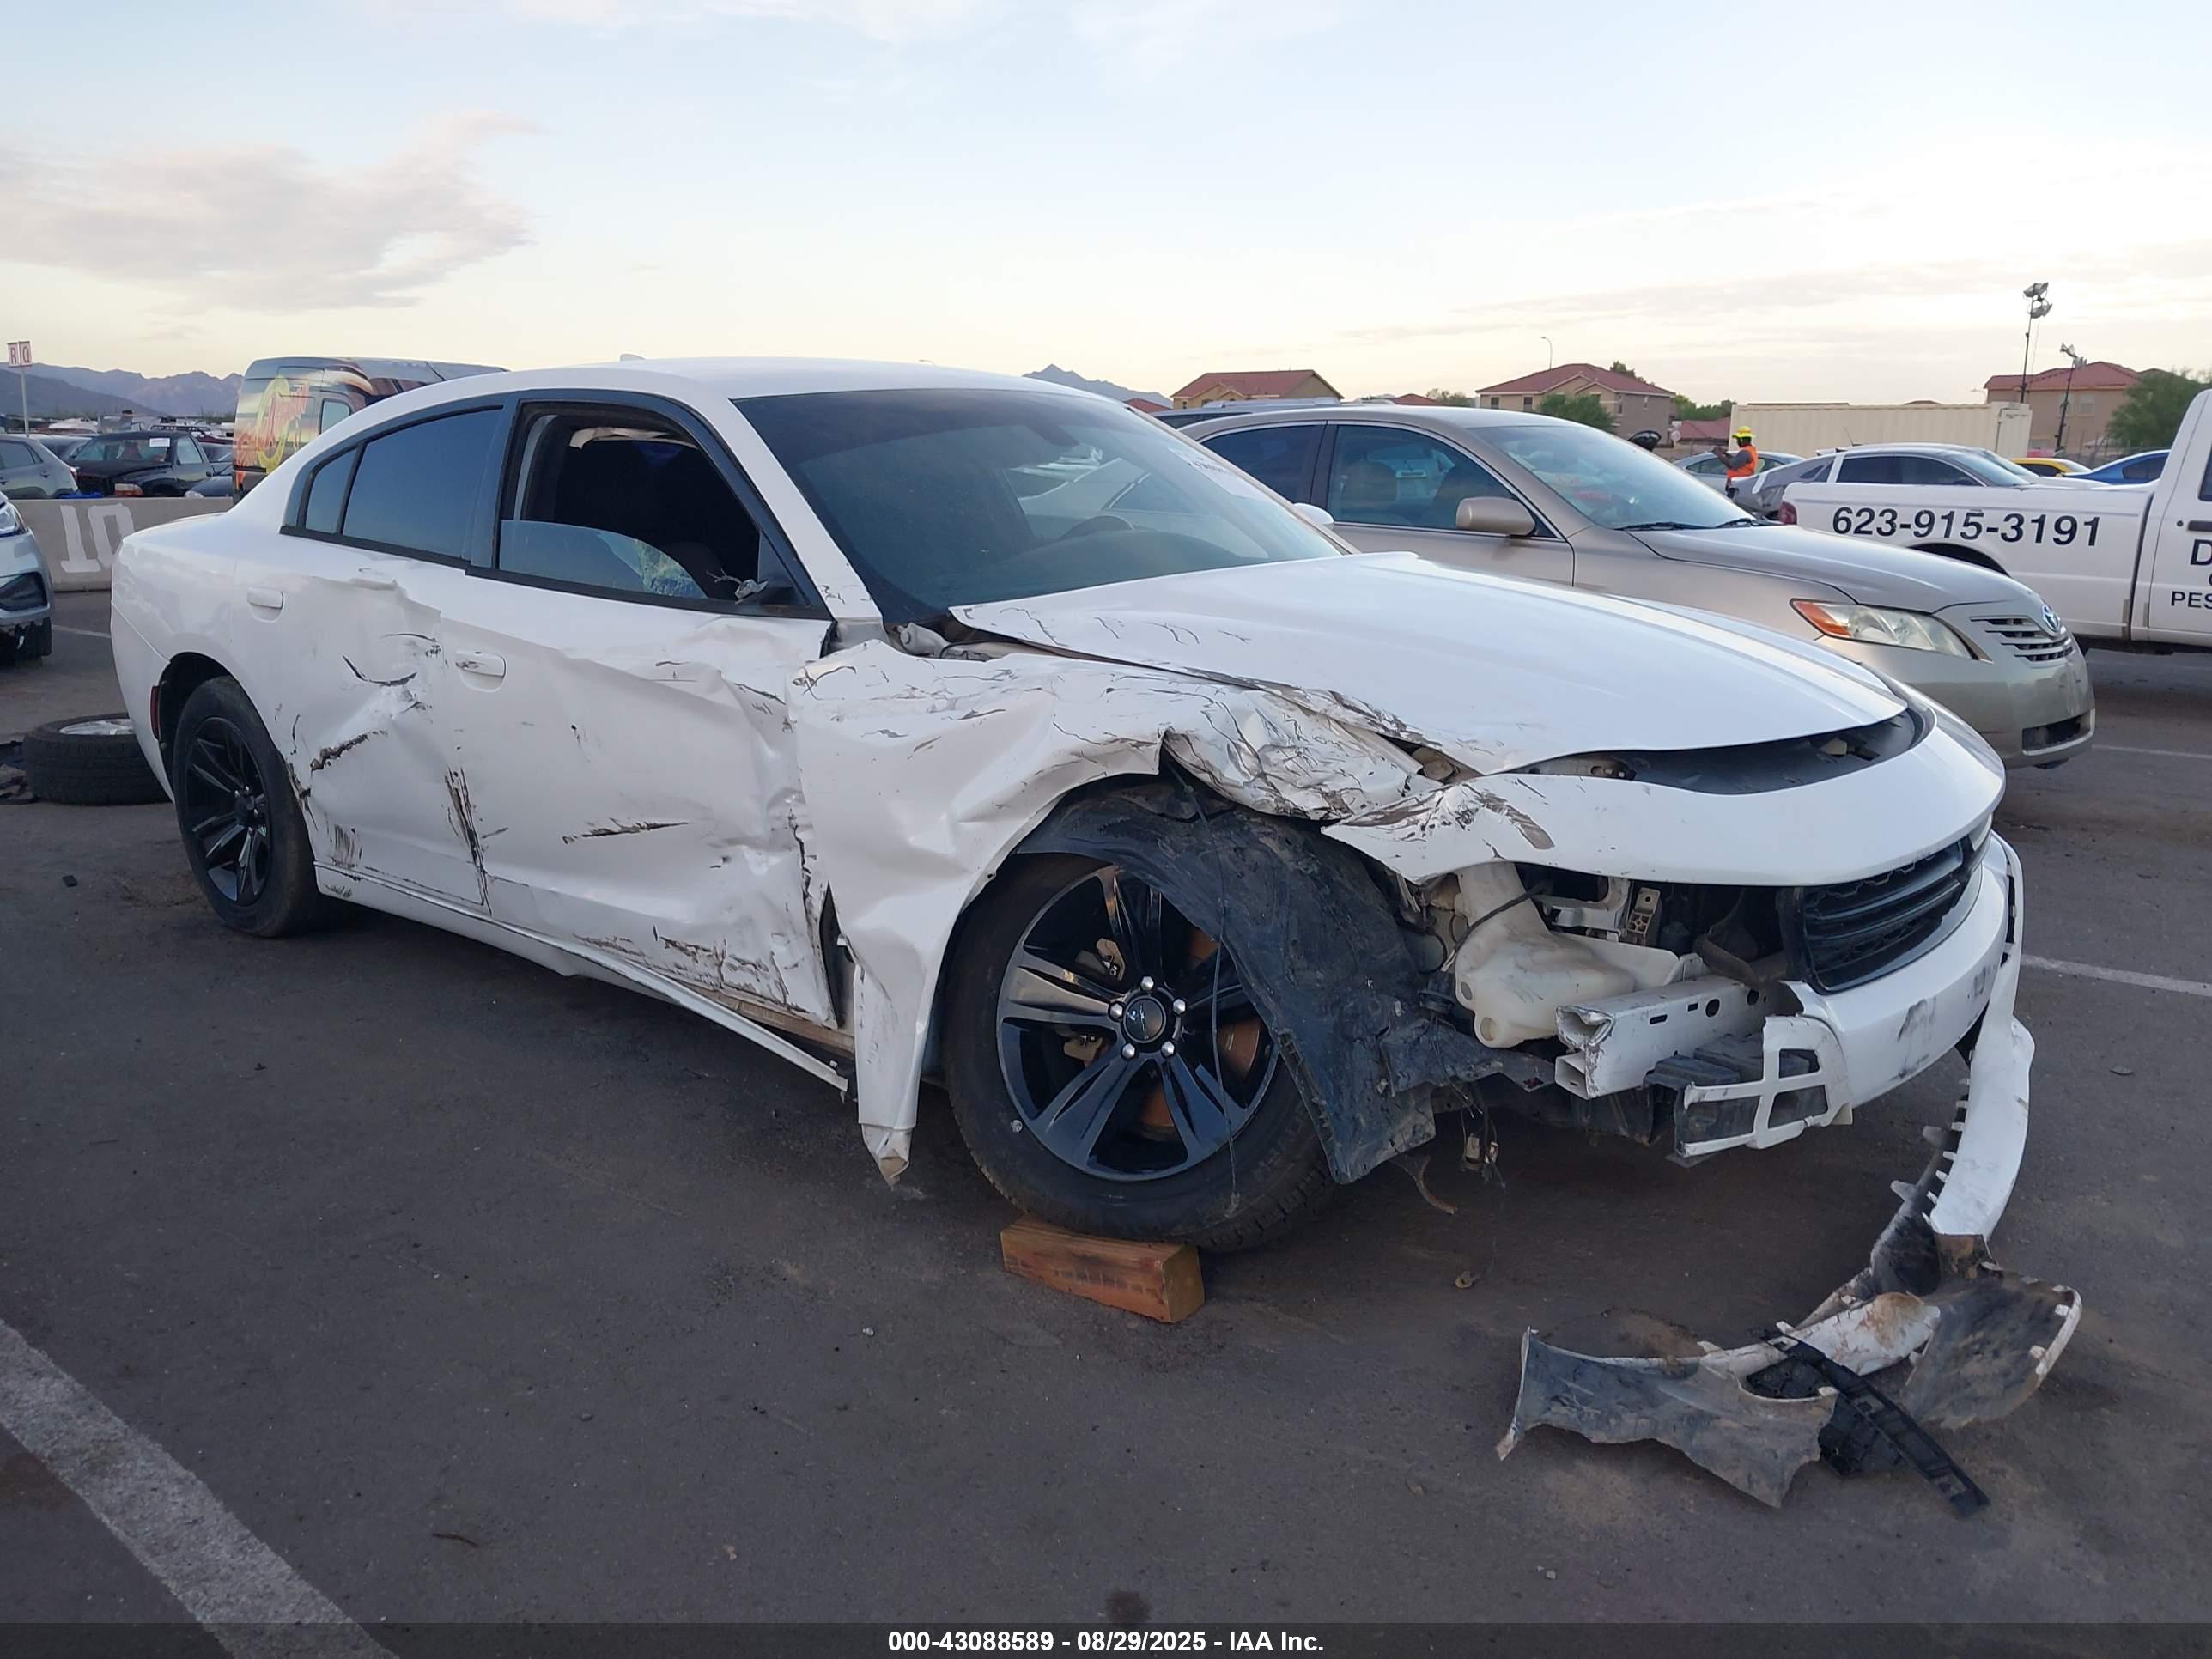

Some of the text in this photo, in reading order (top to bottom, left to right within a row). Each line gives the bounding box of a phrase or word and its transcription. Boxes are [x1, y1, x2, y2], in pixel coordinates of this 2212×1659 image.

[10, 347, 17, 364] R
[60, 502, 135, 573] 10
[1832, 507, 2100, 547] 623-915-3191
